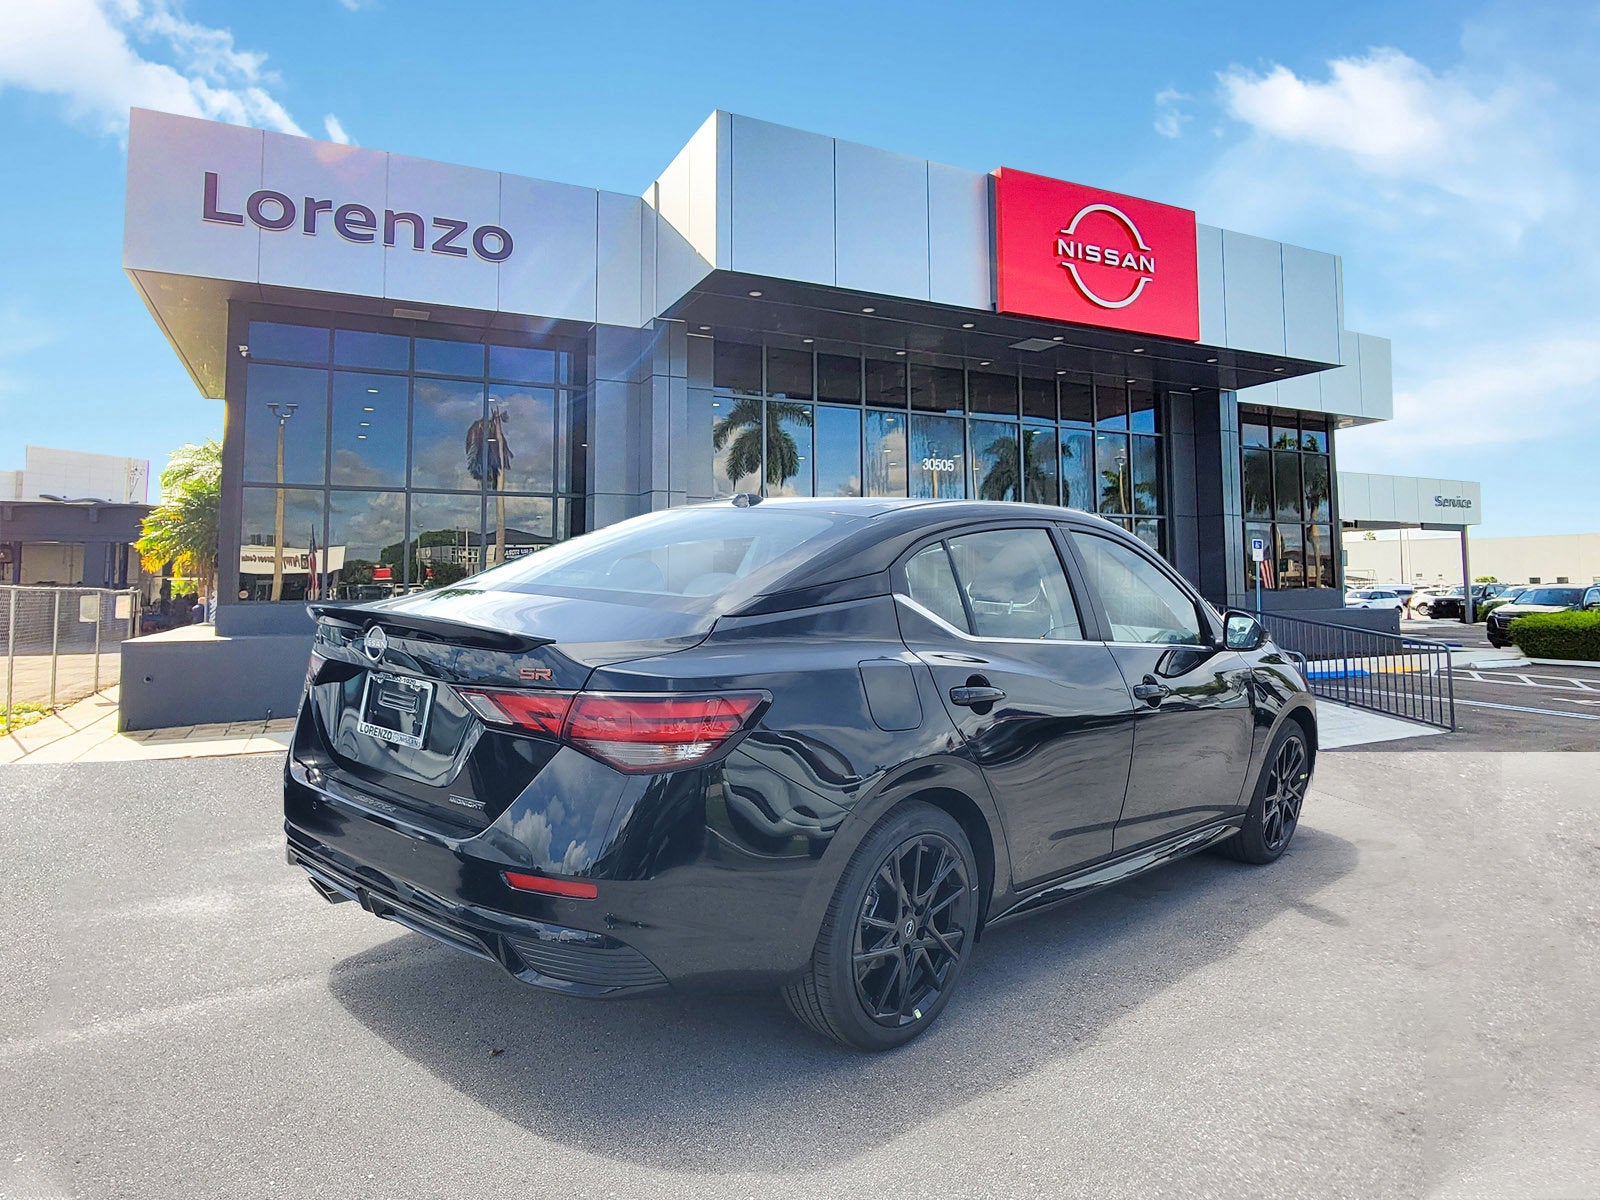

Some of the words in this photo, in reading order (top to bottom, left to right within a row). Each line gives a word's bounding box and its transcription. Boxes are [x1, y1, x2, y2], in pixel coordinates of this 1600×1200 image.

[202, 171, 514, 262] Lorenzo
[1057, 238, 1155, 273] NISSAN
[922, 457, 955, 472] 30505
[1434, 495, 1472, 508] Service
[519, 667, 552, 681] SR
[359, 722, 393, 741] LORENZO
